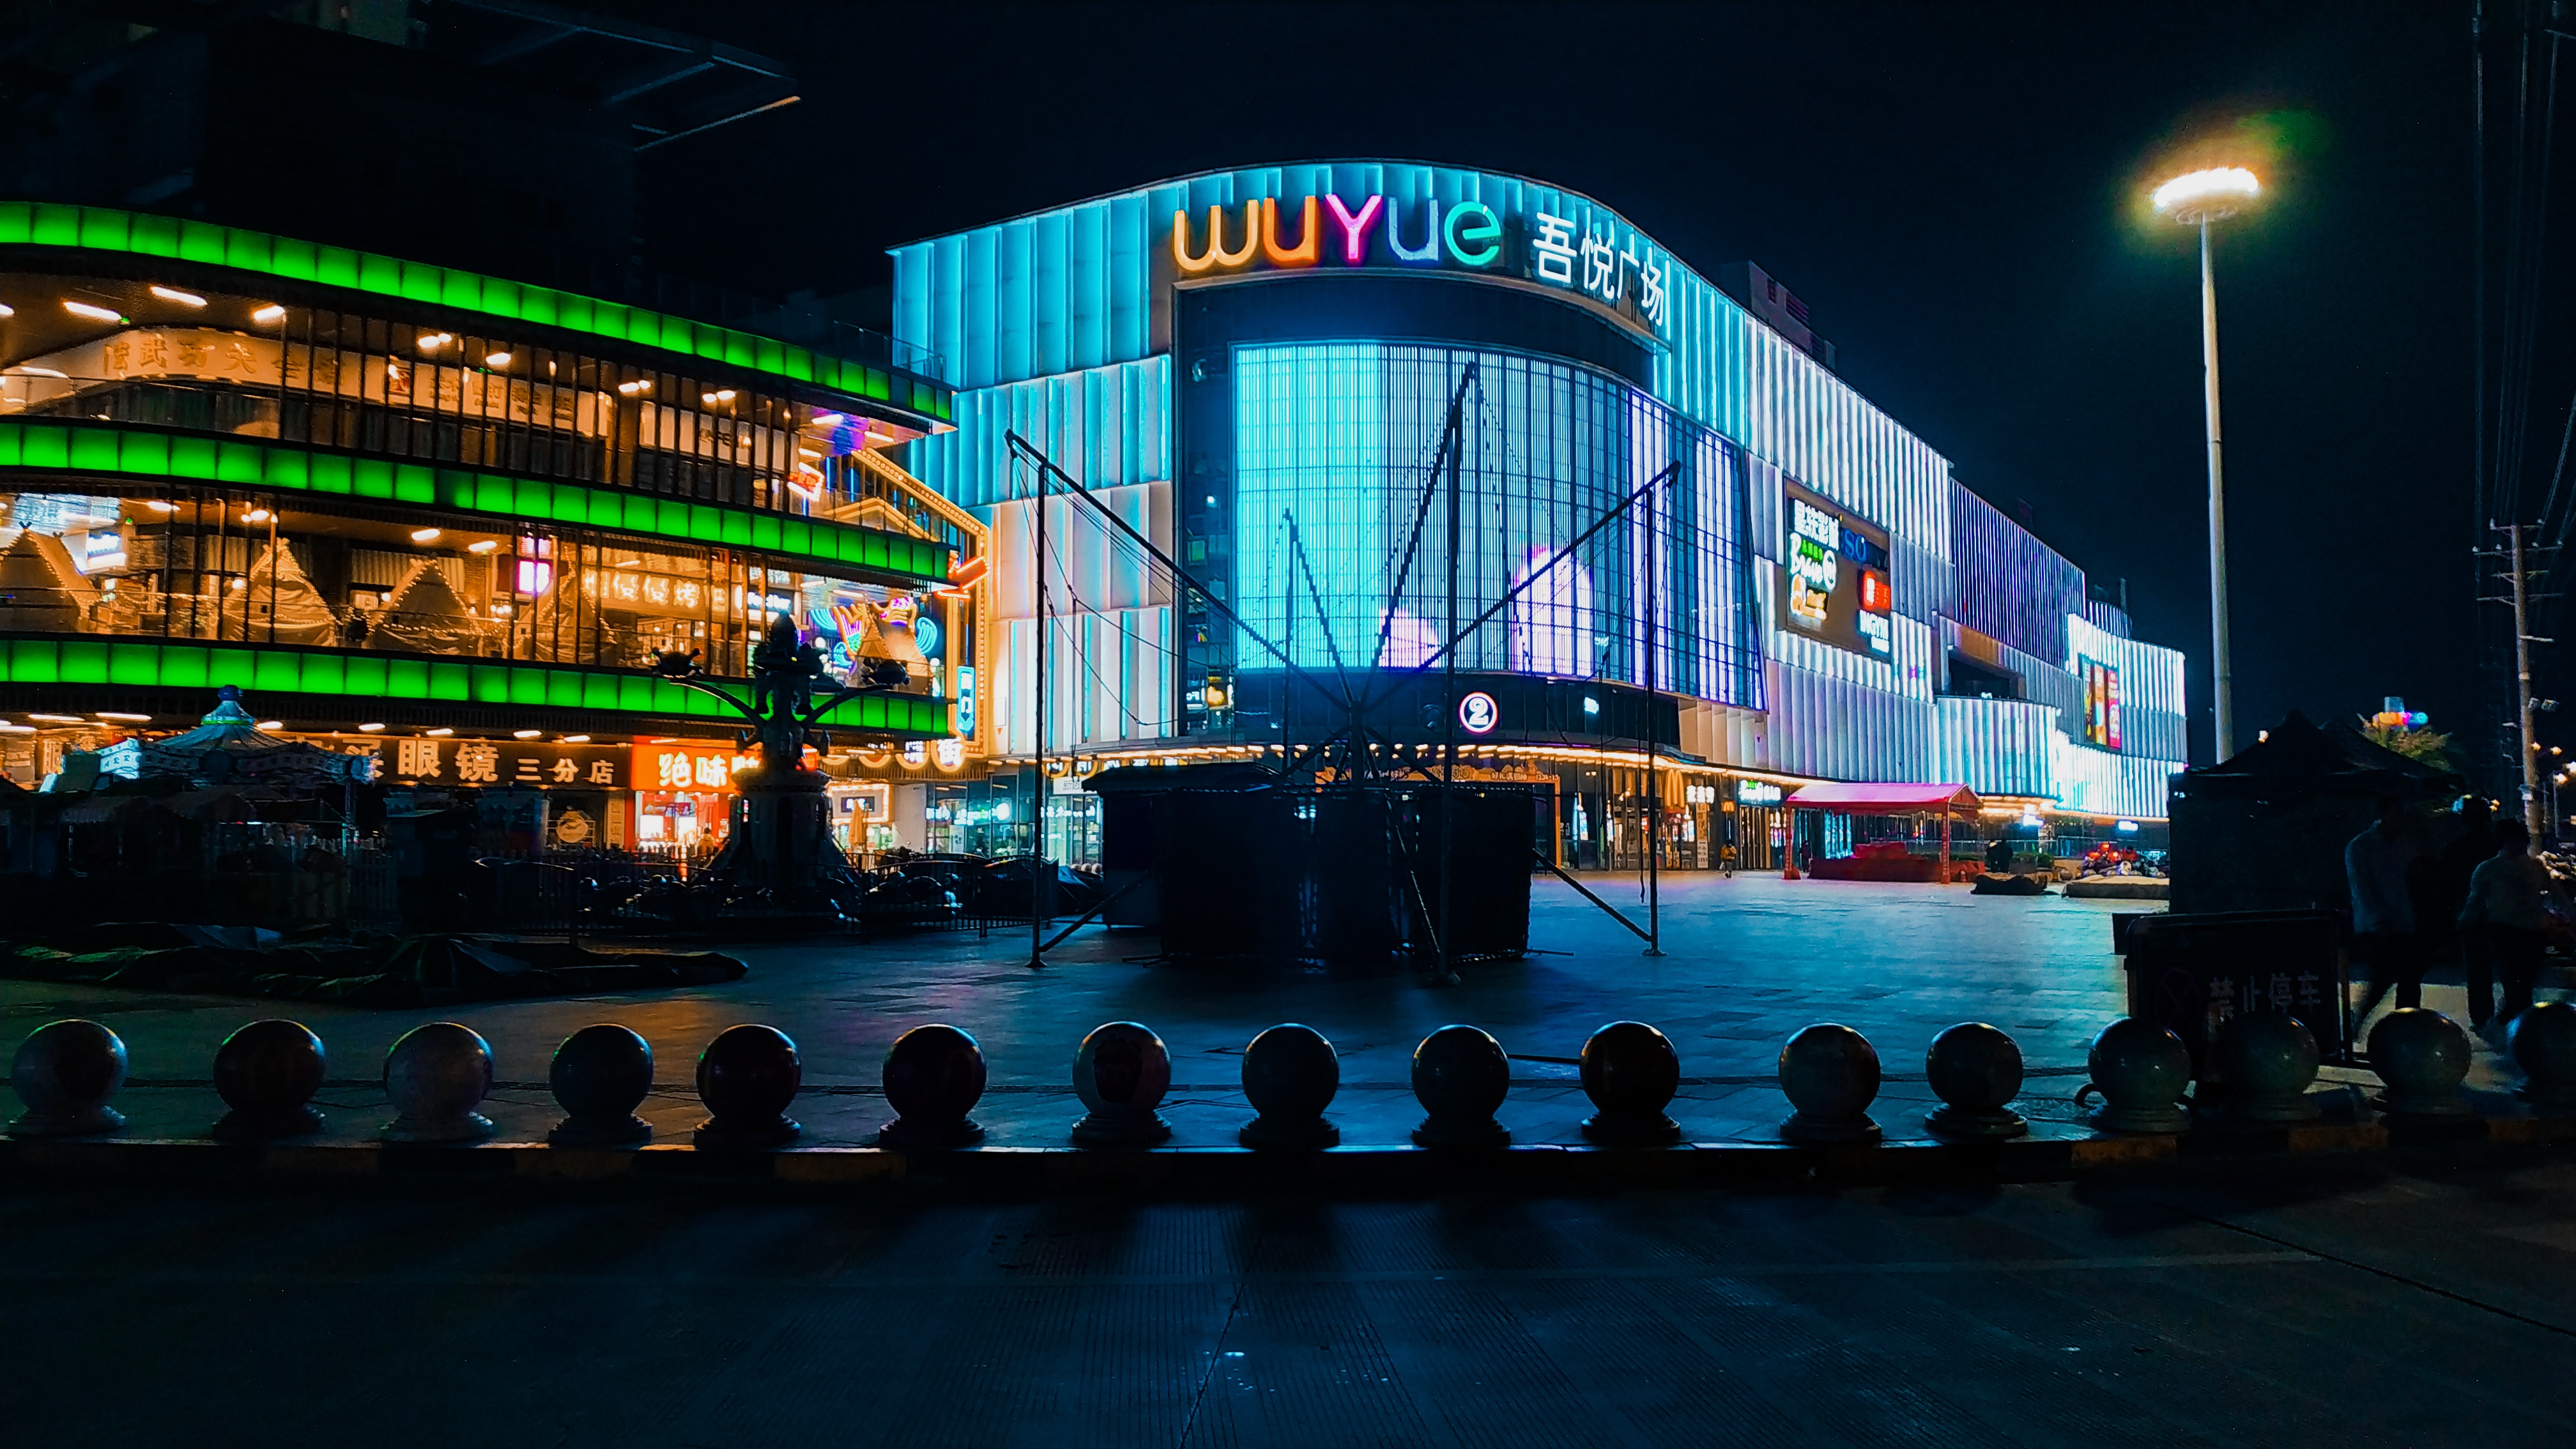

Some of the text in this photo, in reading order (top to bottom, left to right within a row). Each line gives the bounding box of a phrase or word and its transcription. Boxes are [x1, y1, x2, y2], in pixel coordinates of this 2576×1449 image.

[1532, 211, 1666, 328] 吾悦广场
[1469, 696, 1488, 725] 2
[2209, 969, 2322, 1022] 禁止停车
